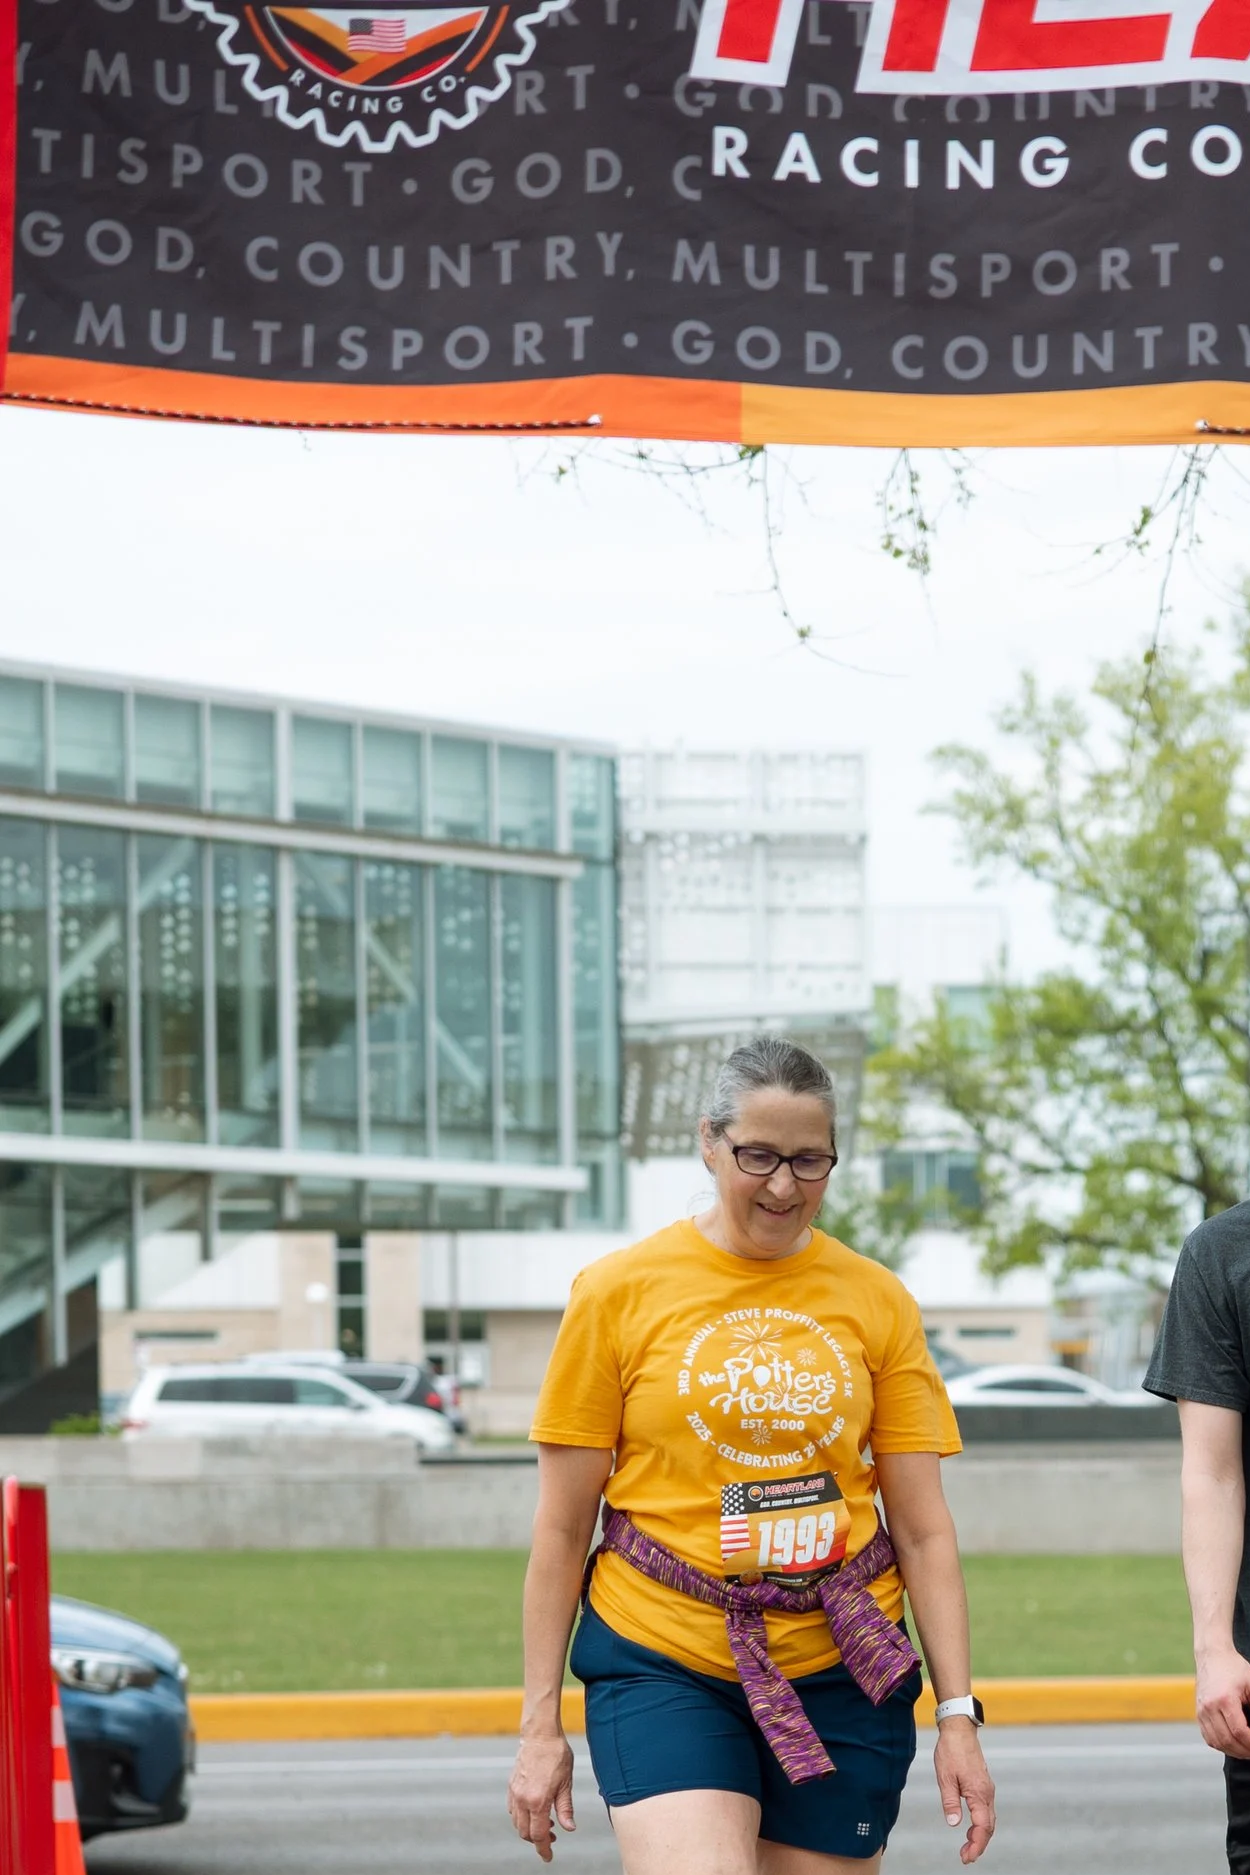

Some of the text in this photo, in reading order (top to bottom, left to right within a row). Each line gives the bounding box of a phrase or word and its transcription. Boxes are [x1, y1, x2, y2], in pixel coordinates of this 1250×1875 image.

[288, 68, 466, 114] RACING CO.
[32, 127, 372, 207] TISPORT
[451, 148, 634, 203] GOD,
[713, 126, 1069, 190] RACING
[21, 211, 204, 277] GOD,
[246, 231, 635, 291] COUNTRY,
[671, 239, 1180, 298] MULTISPORT
[75, 301, 594, 371] MULTISPORT
[672, 320, 852, 380] GOD,
[723, 1308, 761, 1325] STEVE
[765, 1308, 825, 1334] PROFFITT
[682, 1323, 717, 1367] ANNUAL
[822, 1332, 852, 1378] LEGACY
[678, 1369, 690, 1396] 3RD
[698, 1371, 727, 1387] the
[844, 1382, 853, 1399] 5K
[686, 1411, 713, 1442] 2025
[718, 1443, 803, 1468] CELEBRATING
[816, 1415, 845, 1449] YEARS
[740, 1419, 805, 1431] EST. 2000
[758, 1512, 836, 1567] 1993
